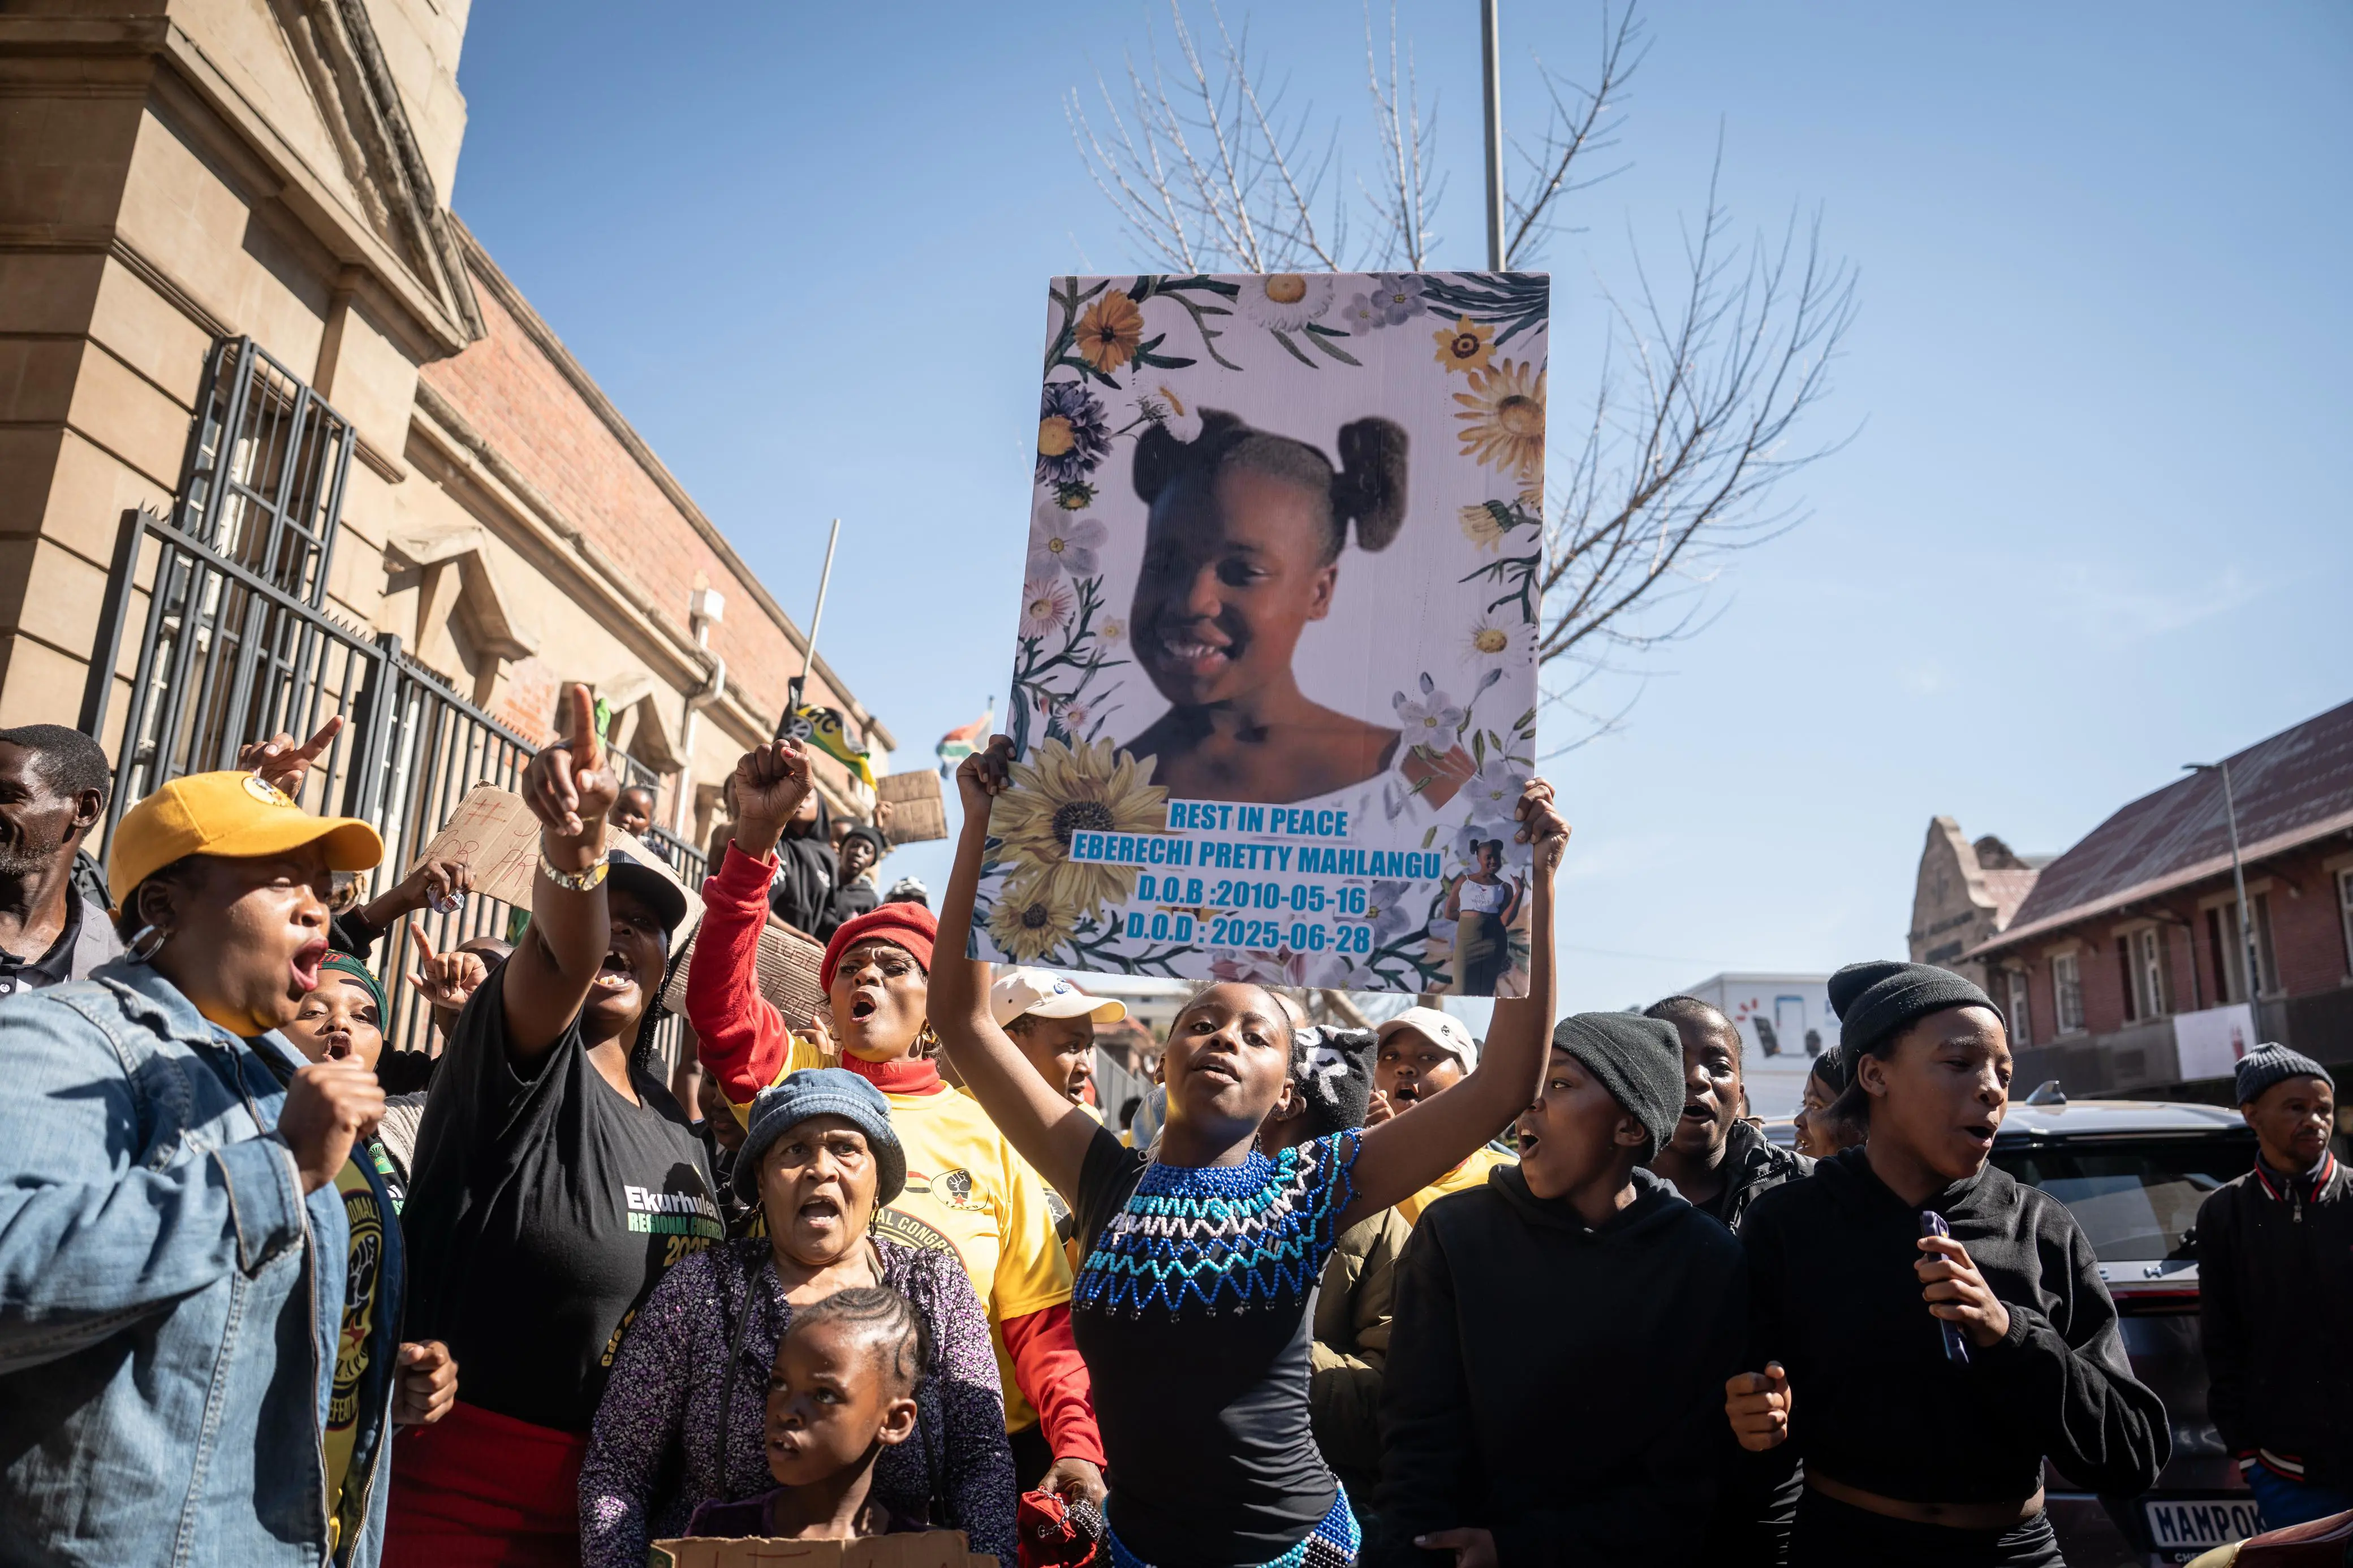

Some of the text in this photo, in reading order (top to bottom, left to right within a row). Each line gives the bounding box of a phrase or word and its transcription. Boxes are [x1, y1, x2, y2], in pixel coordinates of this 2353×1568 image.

[1170, 802, 1348, 836] REST IN PEACE
[1073, 833, 1441, 879] EBERECHI PRETTY MAHLANGU
[1138, 875, 1366, 914] D.O.B :2010-05-16
[1127, 912, 1192, 941] D.O.D
[627, 1212, 688, 1235] REGIONAL
